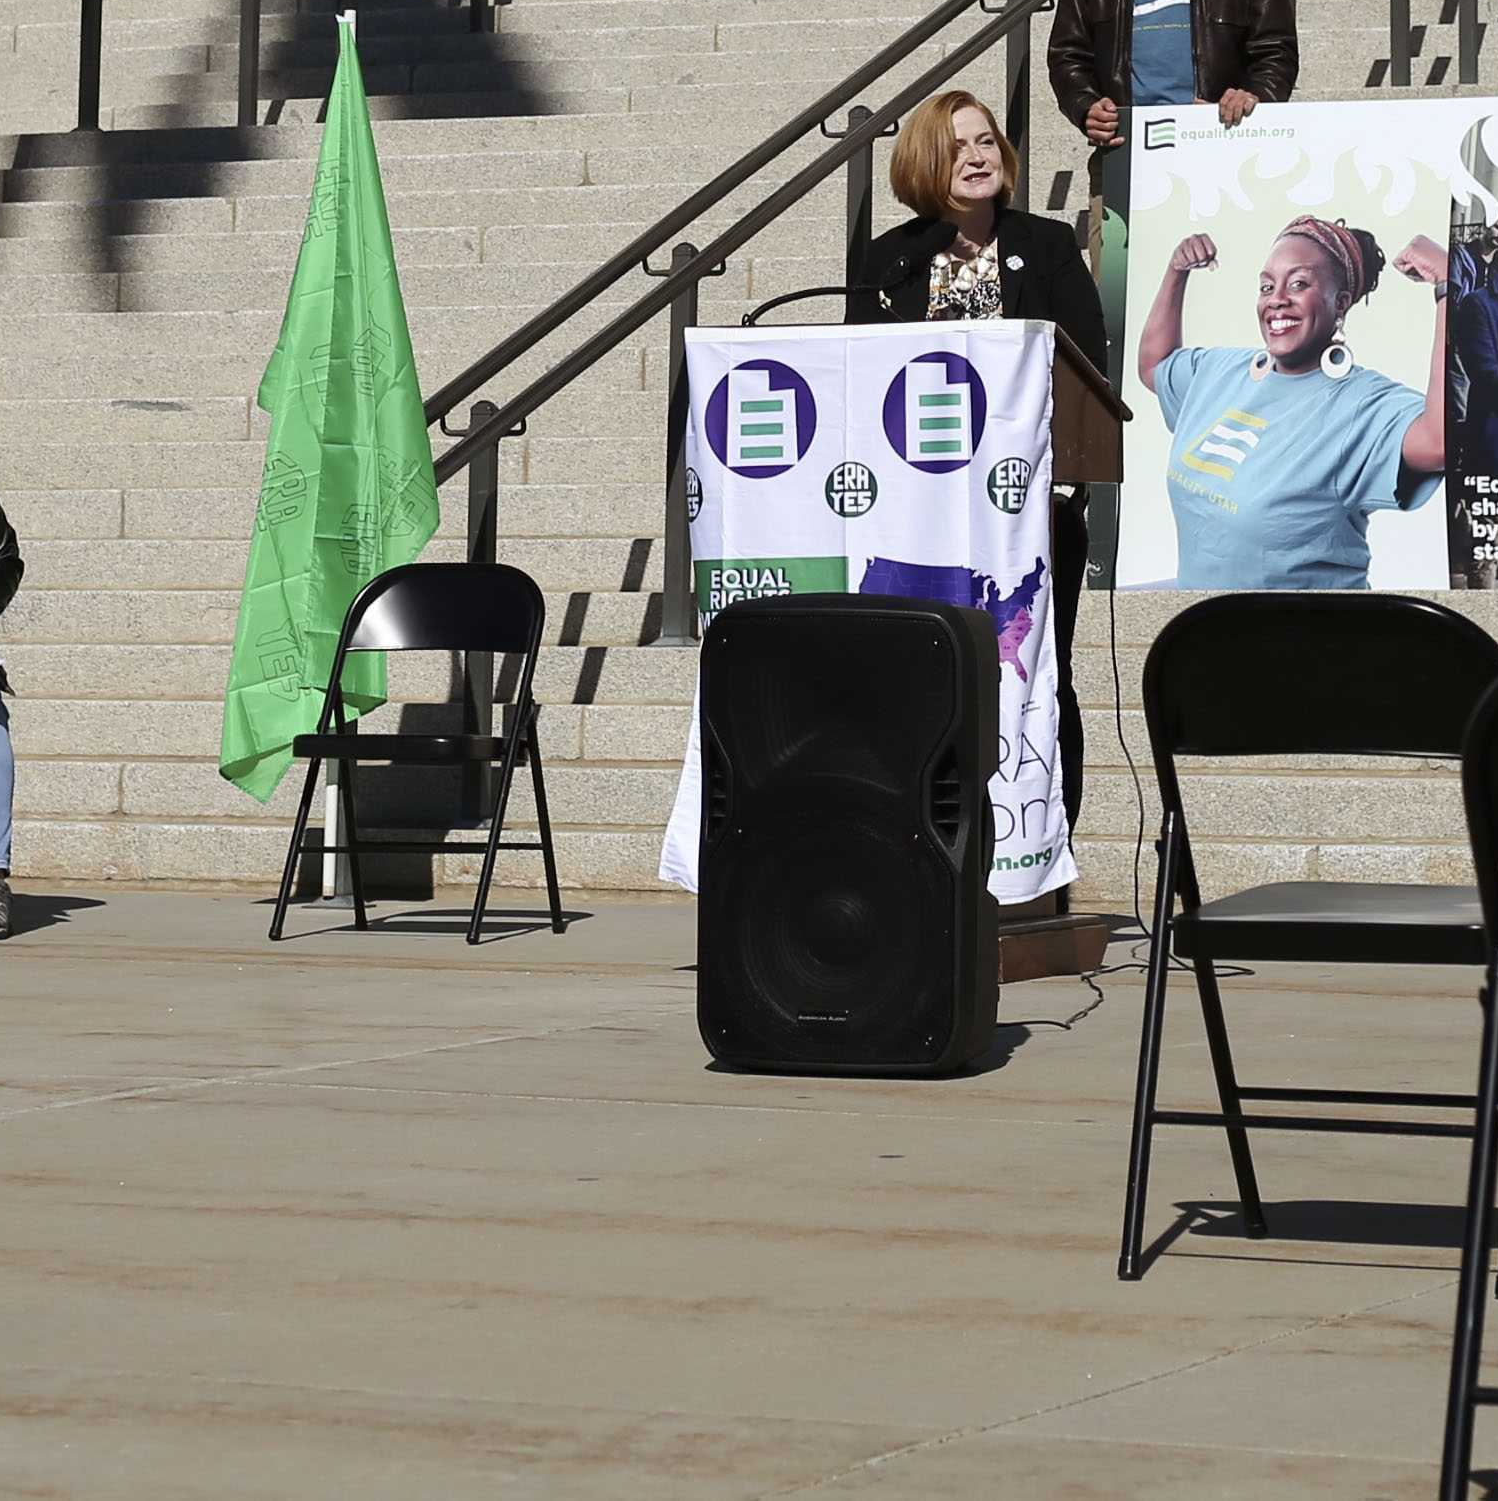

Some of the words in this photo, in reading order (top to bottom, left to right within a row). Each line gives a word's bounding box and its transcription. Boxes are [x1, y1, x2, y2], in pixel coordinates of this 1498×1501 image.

[1181, 126, 1295, 141] equalityutah.org
[833, 463, 869, 490] ERA
[995, 459, 1030, 486] ERA
[829, 491, 872, 513] YES
[710, 568, 790, 589] EQUAL
